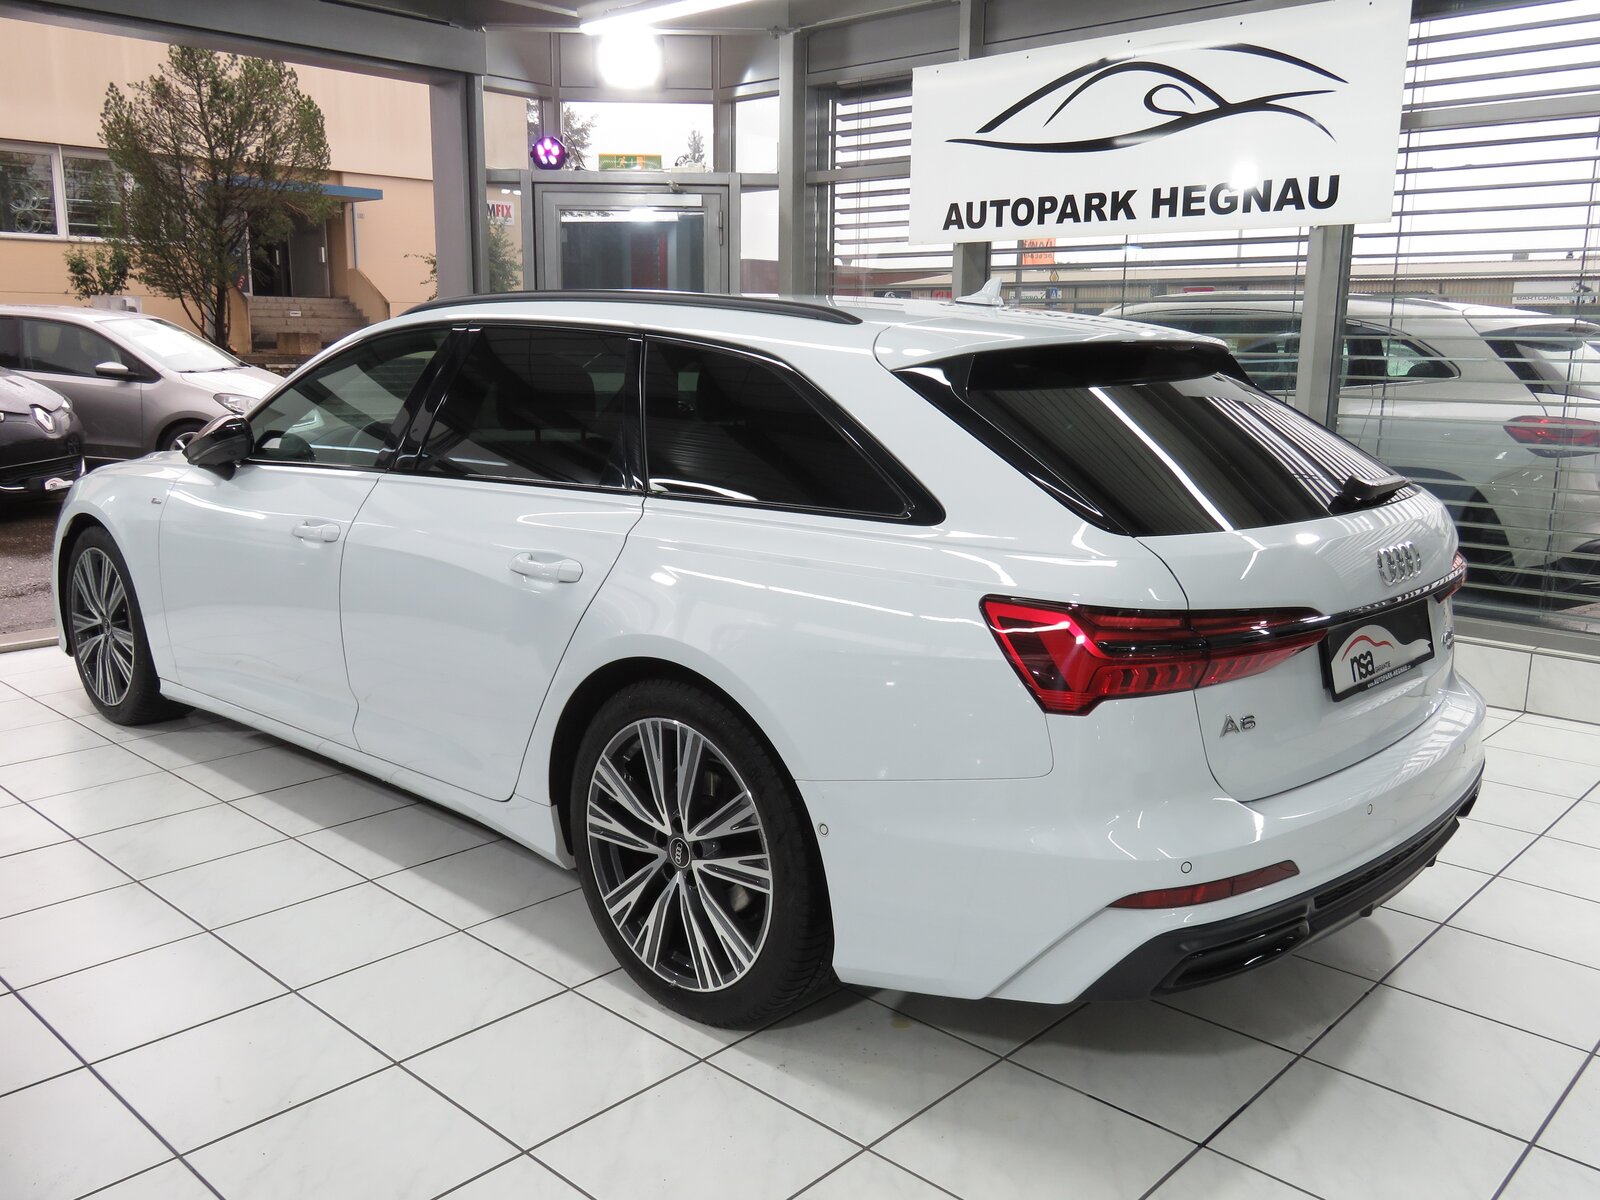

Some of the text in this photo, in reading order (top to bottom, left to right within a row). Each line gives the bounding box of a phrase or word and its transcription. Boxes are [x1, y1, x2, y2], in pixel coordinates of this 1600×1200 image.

[942, 174, 1341, 231] AUTOPARK HEGNAU
[1350, 650, 1375, 682] nsa
[1219, 713, 1256, 738] A6
